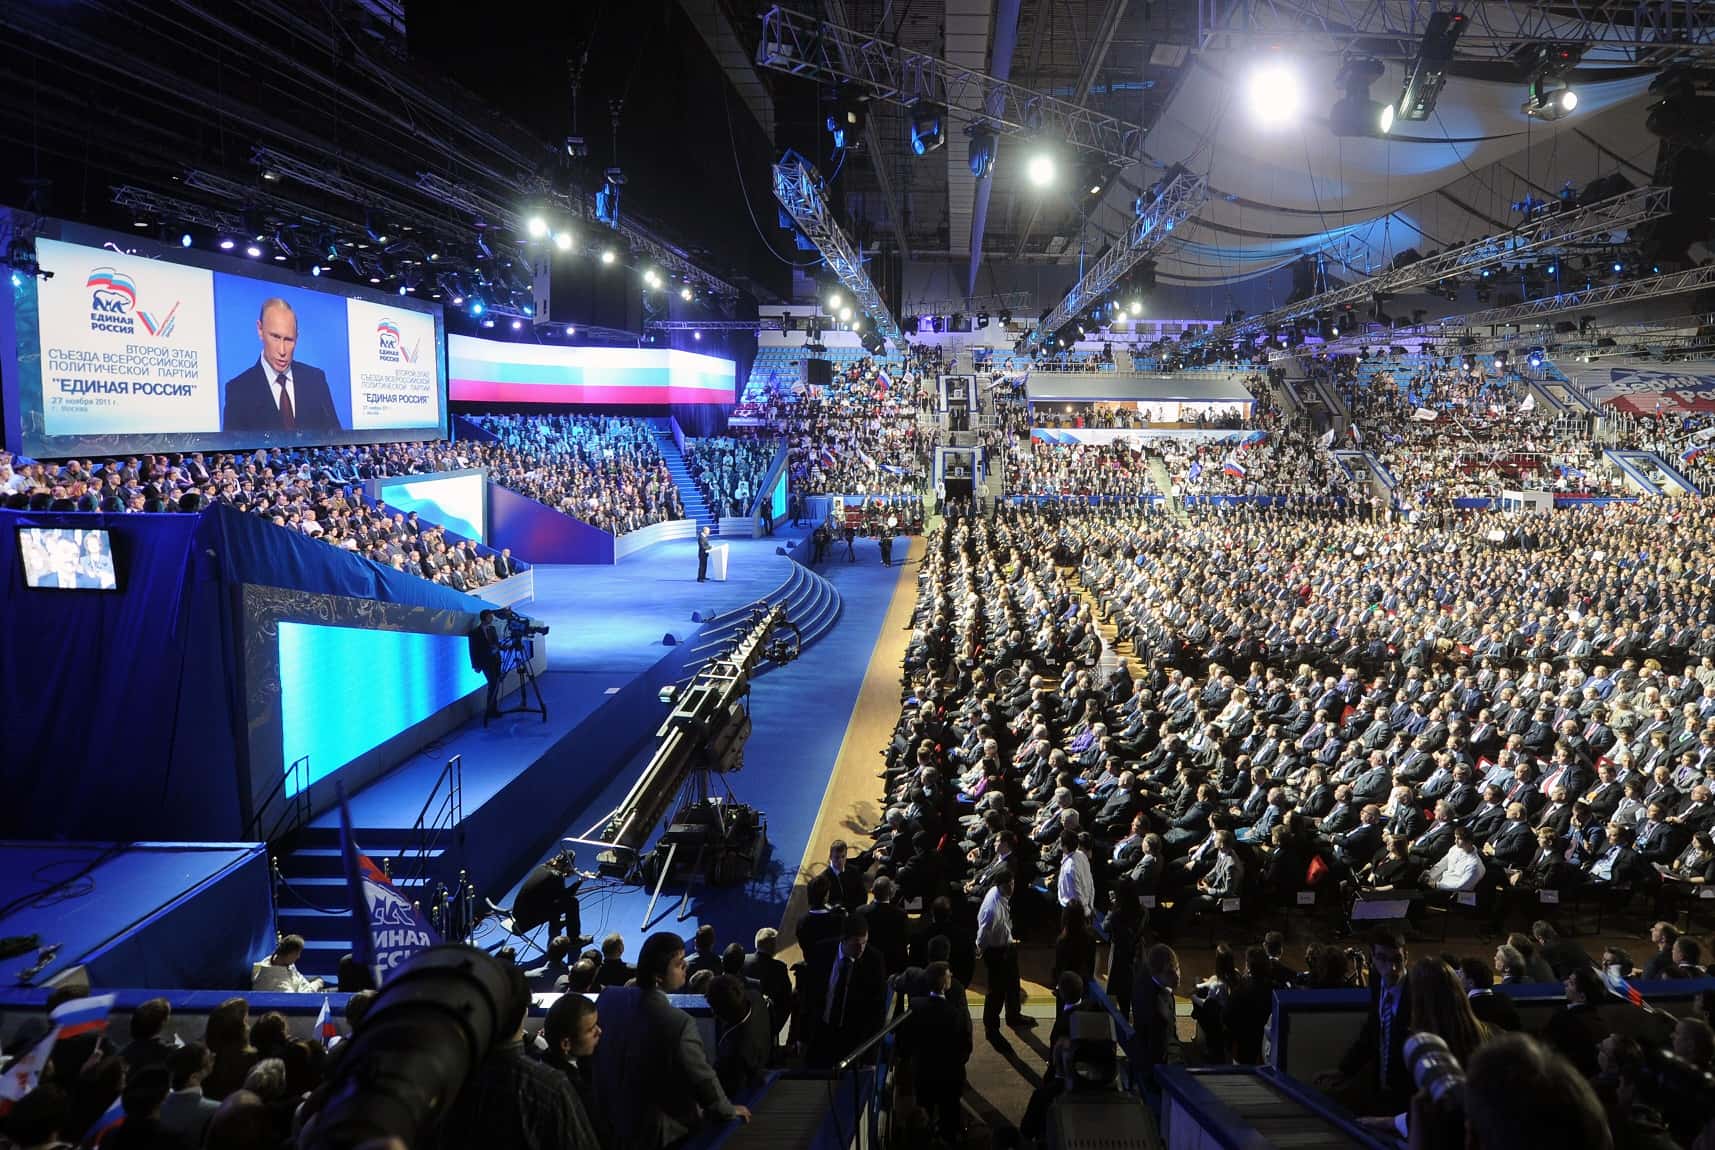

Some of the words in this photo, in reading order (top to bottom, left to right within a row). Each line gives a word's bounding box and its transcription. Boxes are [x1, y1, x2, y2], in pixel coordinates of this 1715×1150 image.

[90, 313, 134, 325] ЕДИНАЯ
[91, 322, 134, 334] РОССИЯ
[48, 348, 100, 362] СЪЕЗДА
[102, 353, 198, 369] ВСЕРОССИЙСКОЙ
[126, 344, 169, 358] ВТОРОЙ
[171, 349, 198, 361] ЭТАП
[49, 360, 150, 377] ПОЛИТИЧЕСКОЙ
[157, 368, 199, 379] ПАРТИИ
[52, 377, 129, 395] "ЕДИНАЯ
[132, 381, 197, 396] РОССИЯ"
[95, 398, 111, 407] 2011
[372, 929, 431, 948] ИНАЯ
